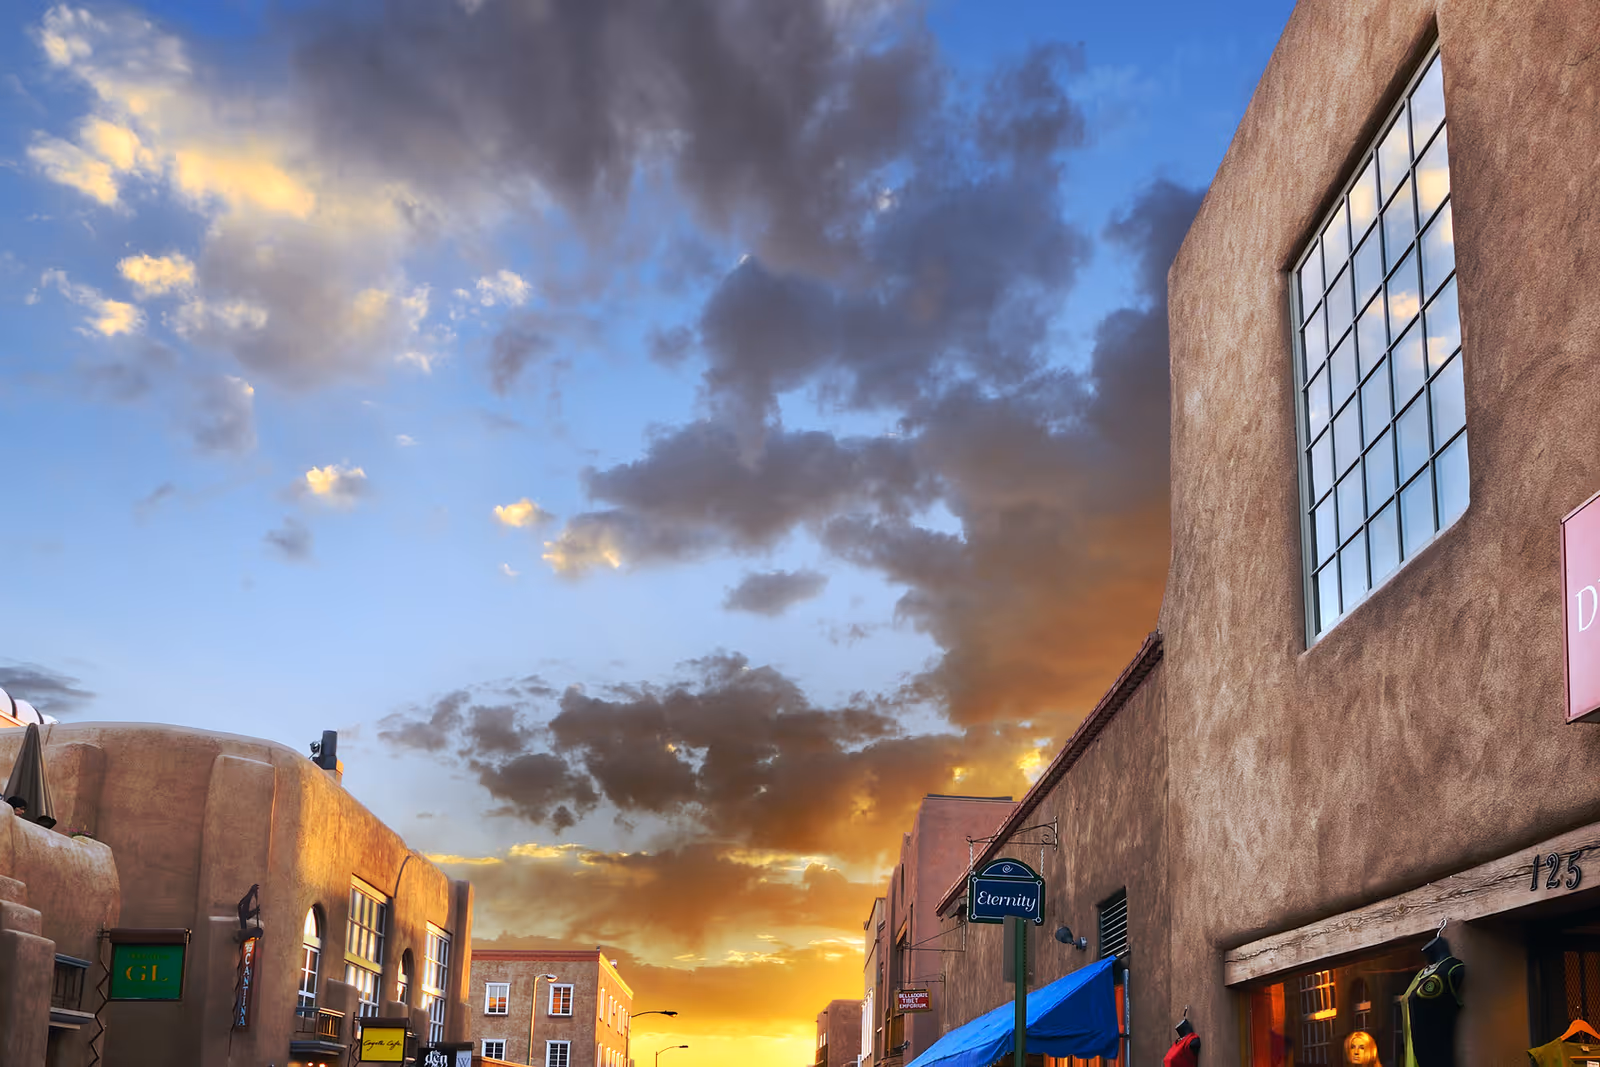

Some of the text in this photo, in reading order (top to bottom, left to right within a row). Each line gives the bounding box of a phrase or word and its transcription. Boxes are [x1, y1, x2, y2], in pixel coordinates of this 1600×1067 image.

[1575, 579, 1600, 632] D
[1529, 850, 1582, 891] 125
[977, 890, 1036, 912] Eternity
[239, 953, 251, 1026] CANTINA
